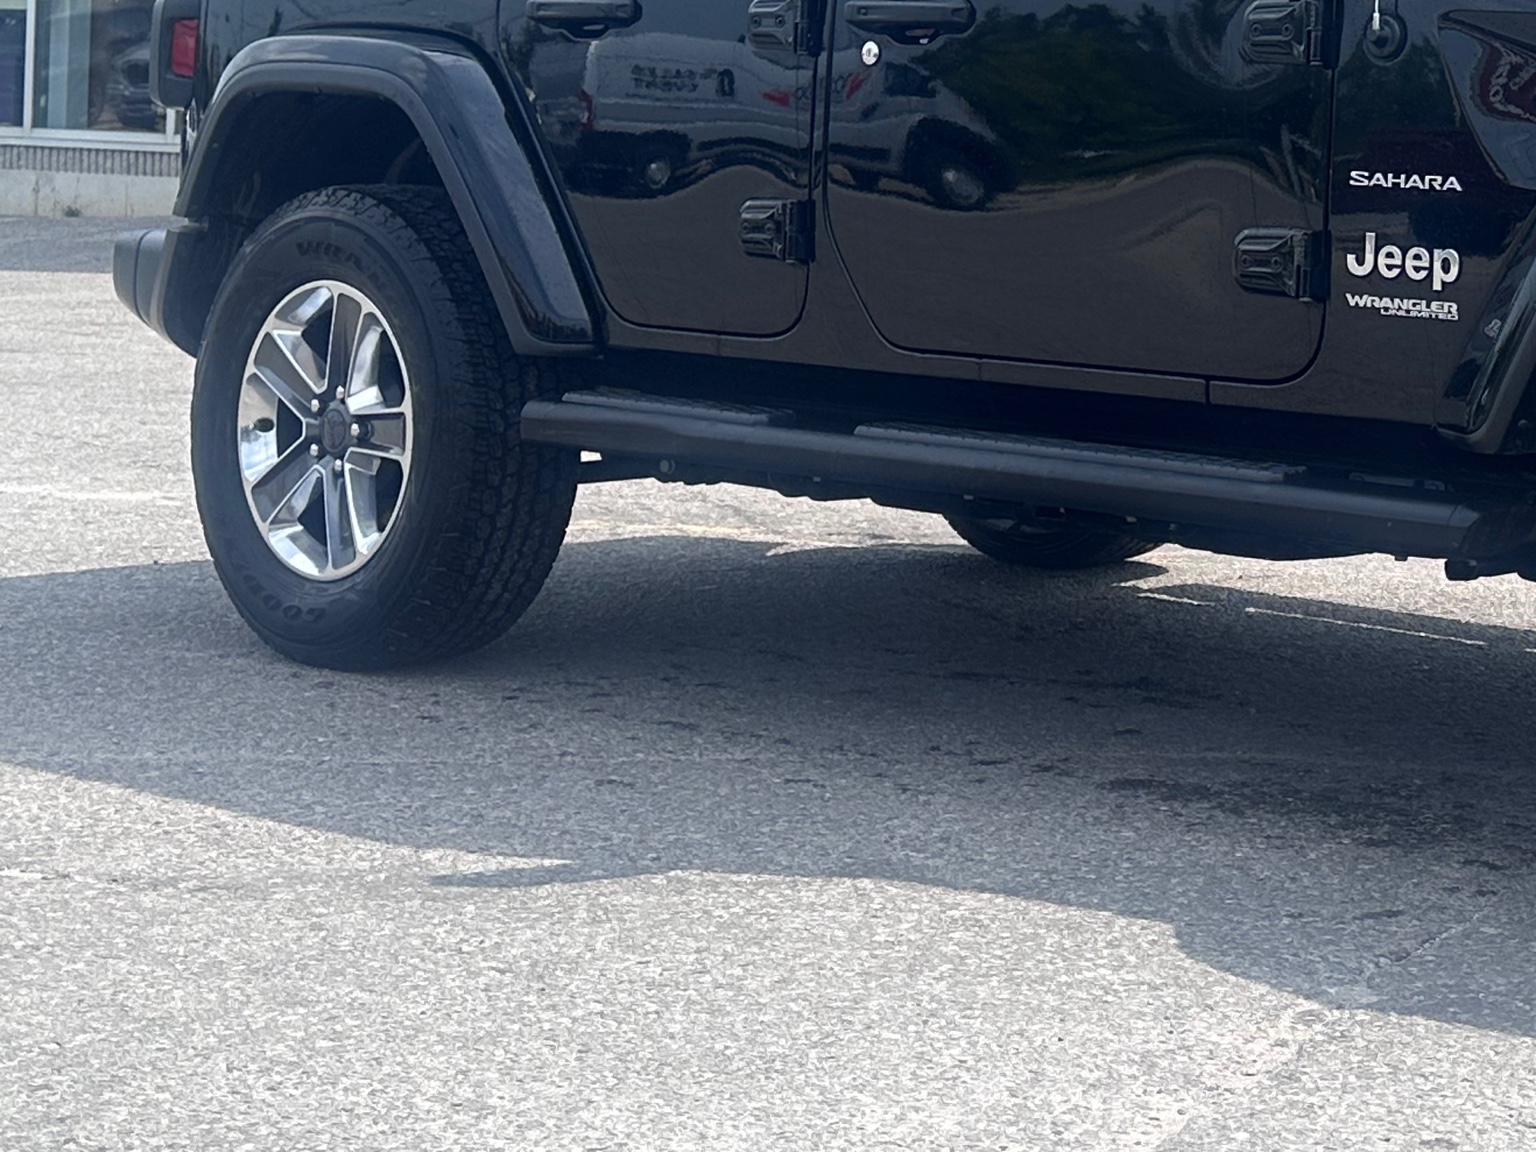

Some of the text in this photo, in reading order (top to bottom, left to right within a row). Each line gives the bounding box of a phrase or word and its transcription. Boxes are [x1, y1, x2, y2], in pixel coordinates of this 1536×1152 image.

[1348, 170, 1463, 192] SAHARA
[1346, 231, 1461, 291] Jeep
[1345, 292, 1459, 315] WRANGLER
[1380, 308, 1459, 321] UNLIMITED
